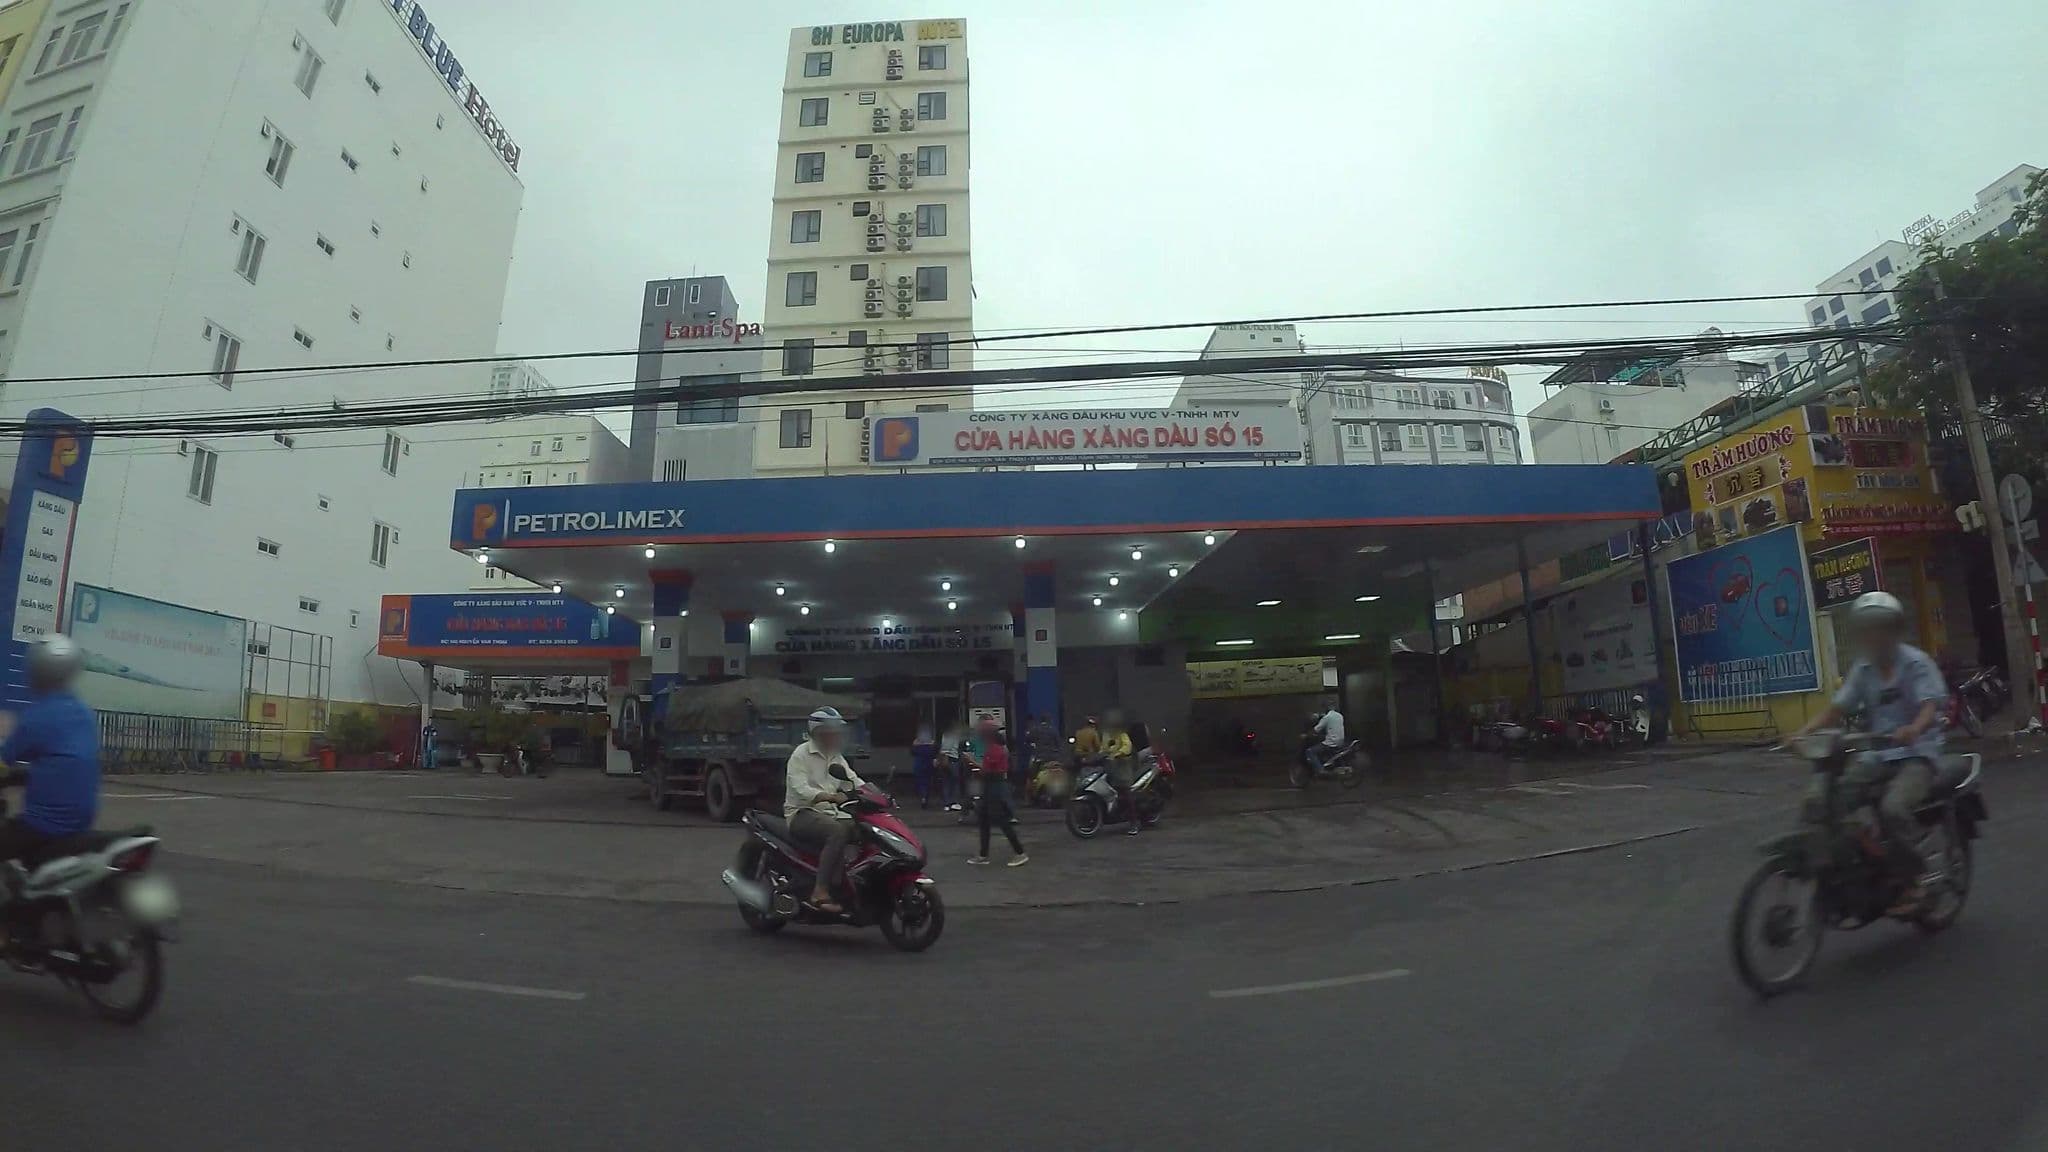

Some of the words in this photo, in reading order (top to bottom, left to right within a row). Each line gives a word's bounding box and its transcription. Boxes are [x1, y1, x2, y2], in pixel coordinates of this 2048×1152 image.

[842, 22, 904, 44] EUROPA
[408, 3, 464, 94] BLUE
[464, 82, 521, 173] Hotel
[1905, 214, 1935, 237] ROYAL
[665, 319, 715, 340] Lani
[721, 318, 761, 344] Spa
[1011, 412, 1027, 422] TY
[1100, 411, 1126, 420] KHU
[1130, 411, 1157, 421] VỰC
[1213, 410, 1240, 419] MTV
[954, 425, 1003, 451] CỬA
[1008, 425, 1076, 450] HÀNG
[1083, 424, 1149, 448] XĂNG
[1154, 422, 1198, 448] DẦU
[1205, 421, 1236, 447] SỐ
[1243, 426, 1264, 446] 15
[1692, 445, 1734, 479] TRẦM
[1735, 425, 1794, 464] HƯƠNG
[41, 526, 54, 536] GAS
[514, 508, 685, 534] PETROLIMEX
